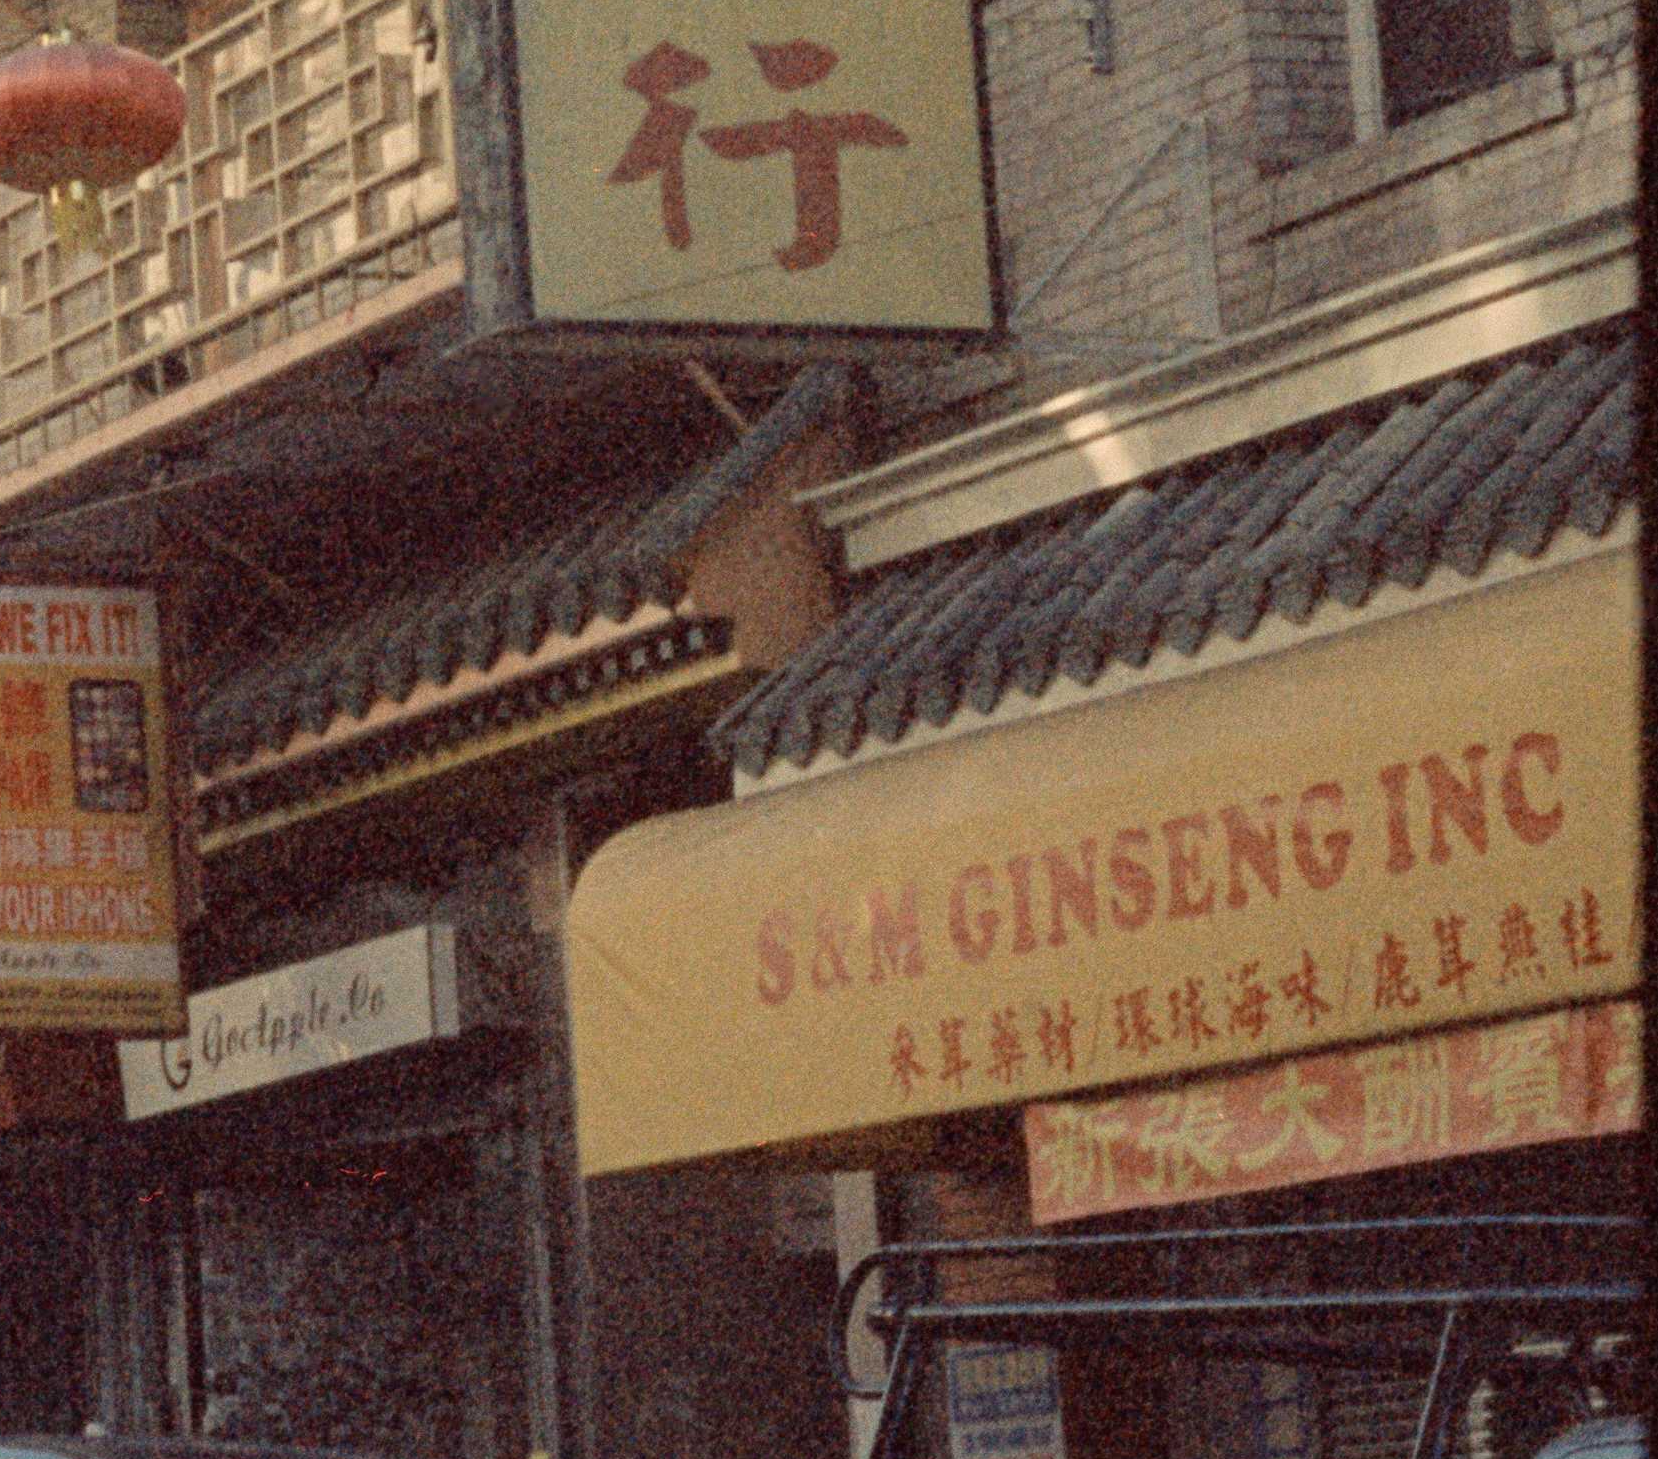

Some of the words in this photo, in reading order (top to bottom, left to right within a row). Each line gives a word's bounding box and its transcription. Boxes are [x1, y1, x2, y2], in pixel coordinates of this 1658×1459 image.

[45, 603, 96, 657] FIX
[101, 605, 141, 659] IT!
[755, 881, 926, 1008] S&M
[947, 777, 1356, 967] GINSENG
[1377, 730, 1569, 876] INC
